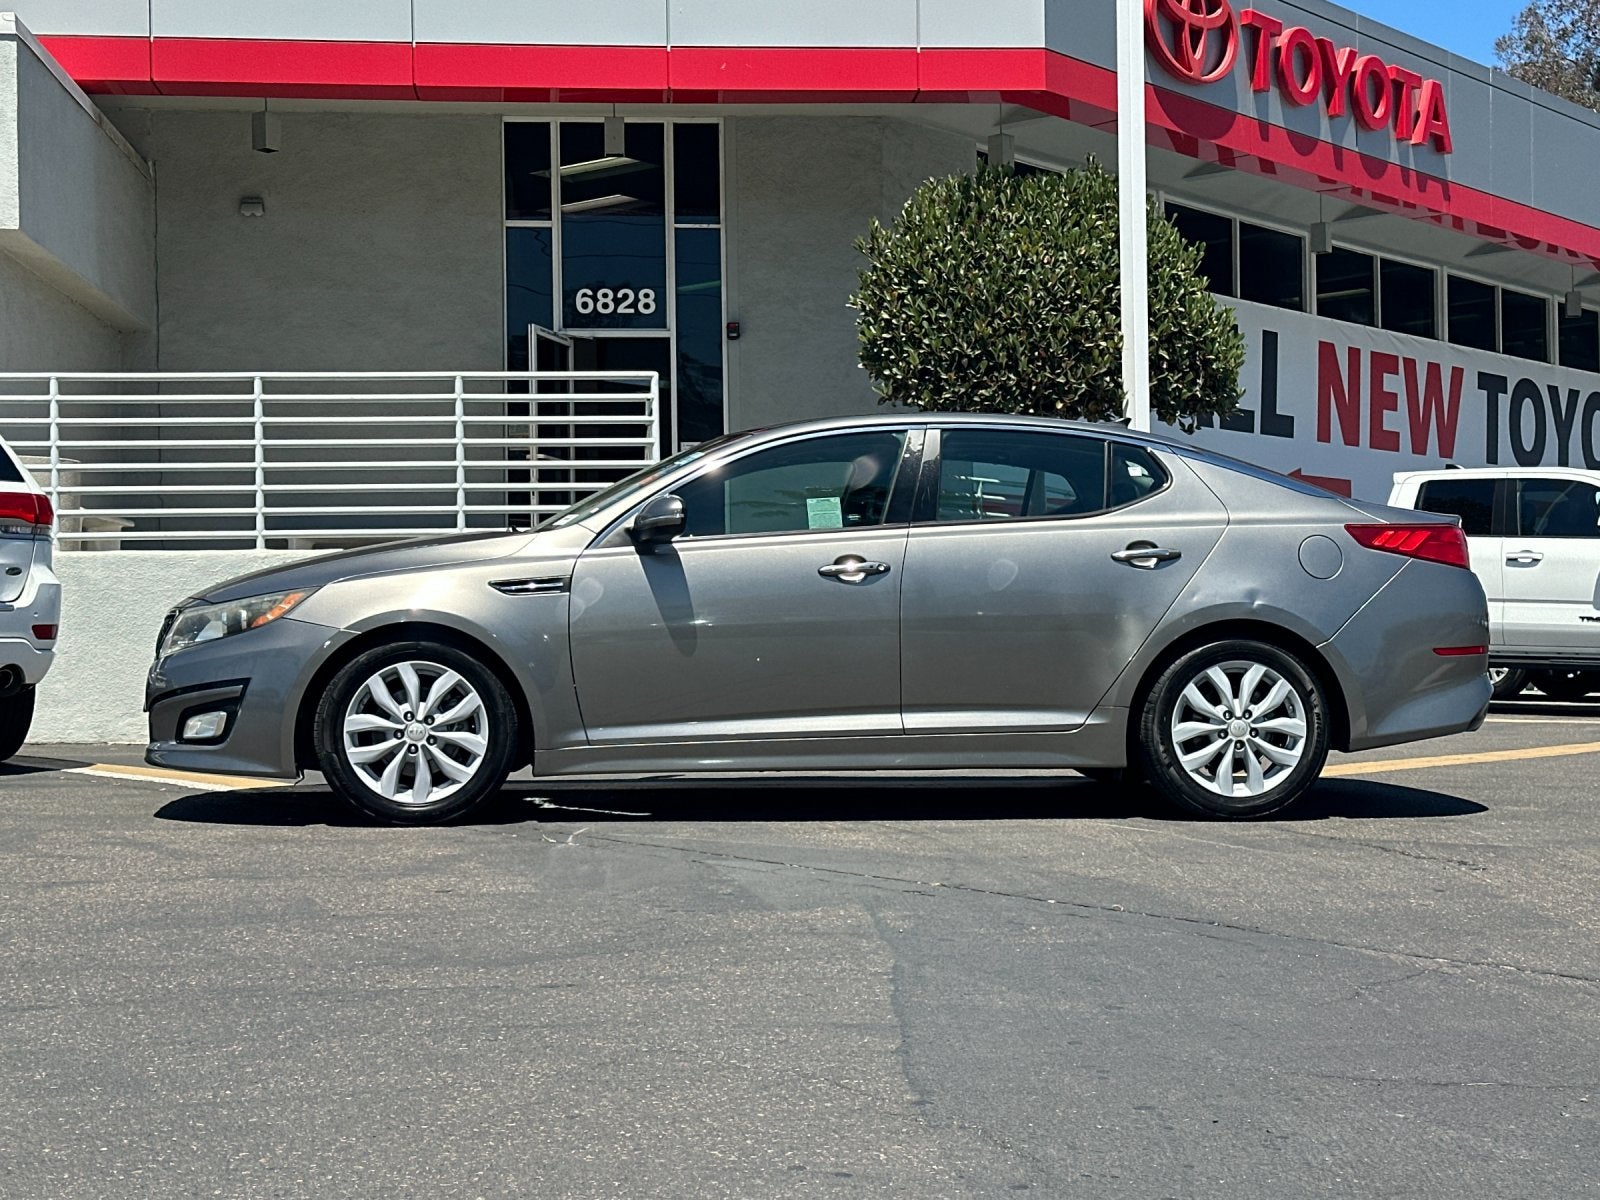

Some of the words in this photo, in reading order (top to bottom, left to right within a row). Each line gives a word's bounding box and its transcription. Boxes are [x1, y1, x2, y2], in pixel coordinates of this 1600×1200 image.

[1240, 8, 1452, 153] TOYOTA
[575, 288, 656, 314] 6828
[1317, 340, 1464, 459] NEW
